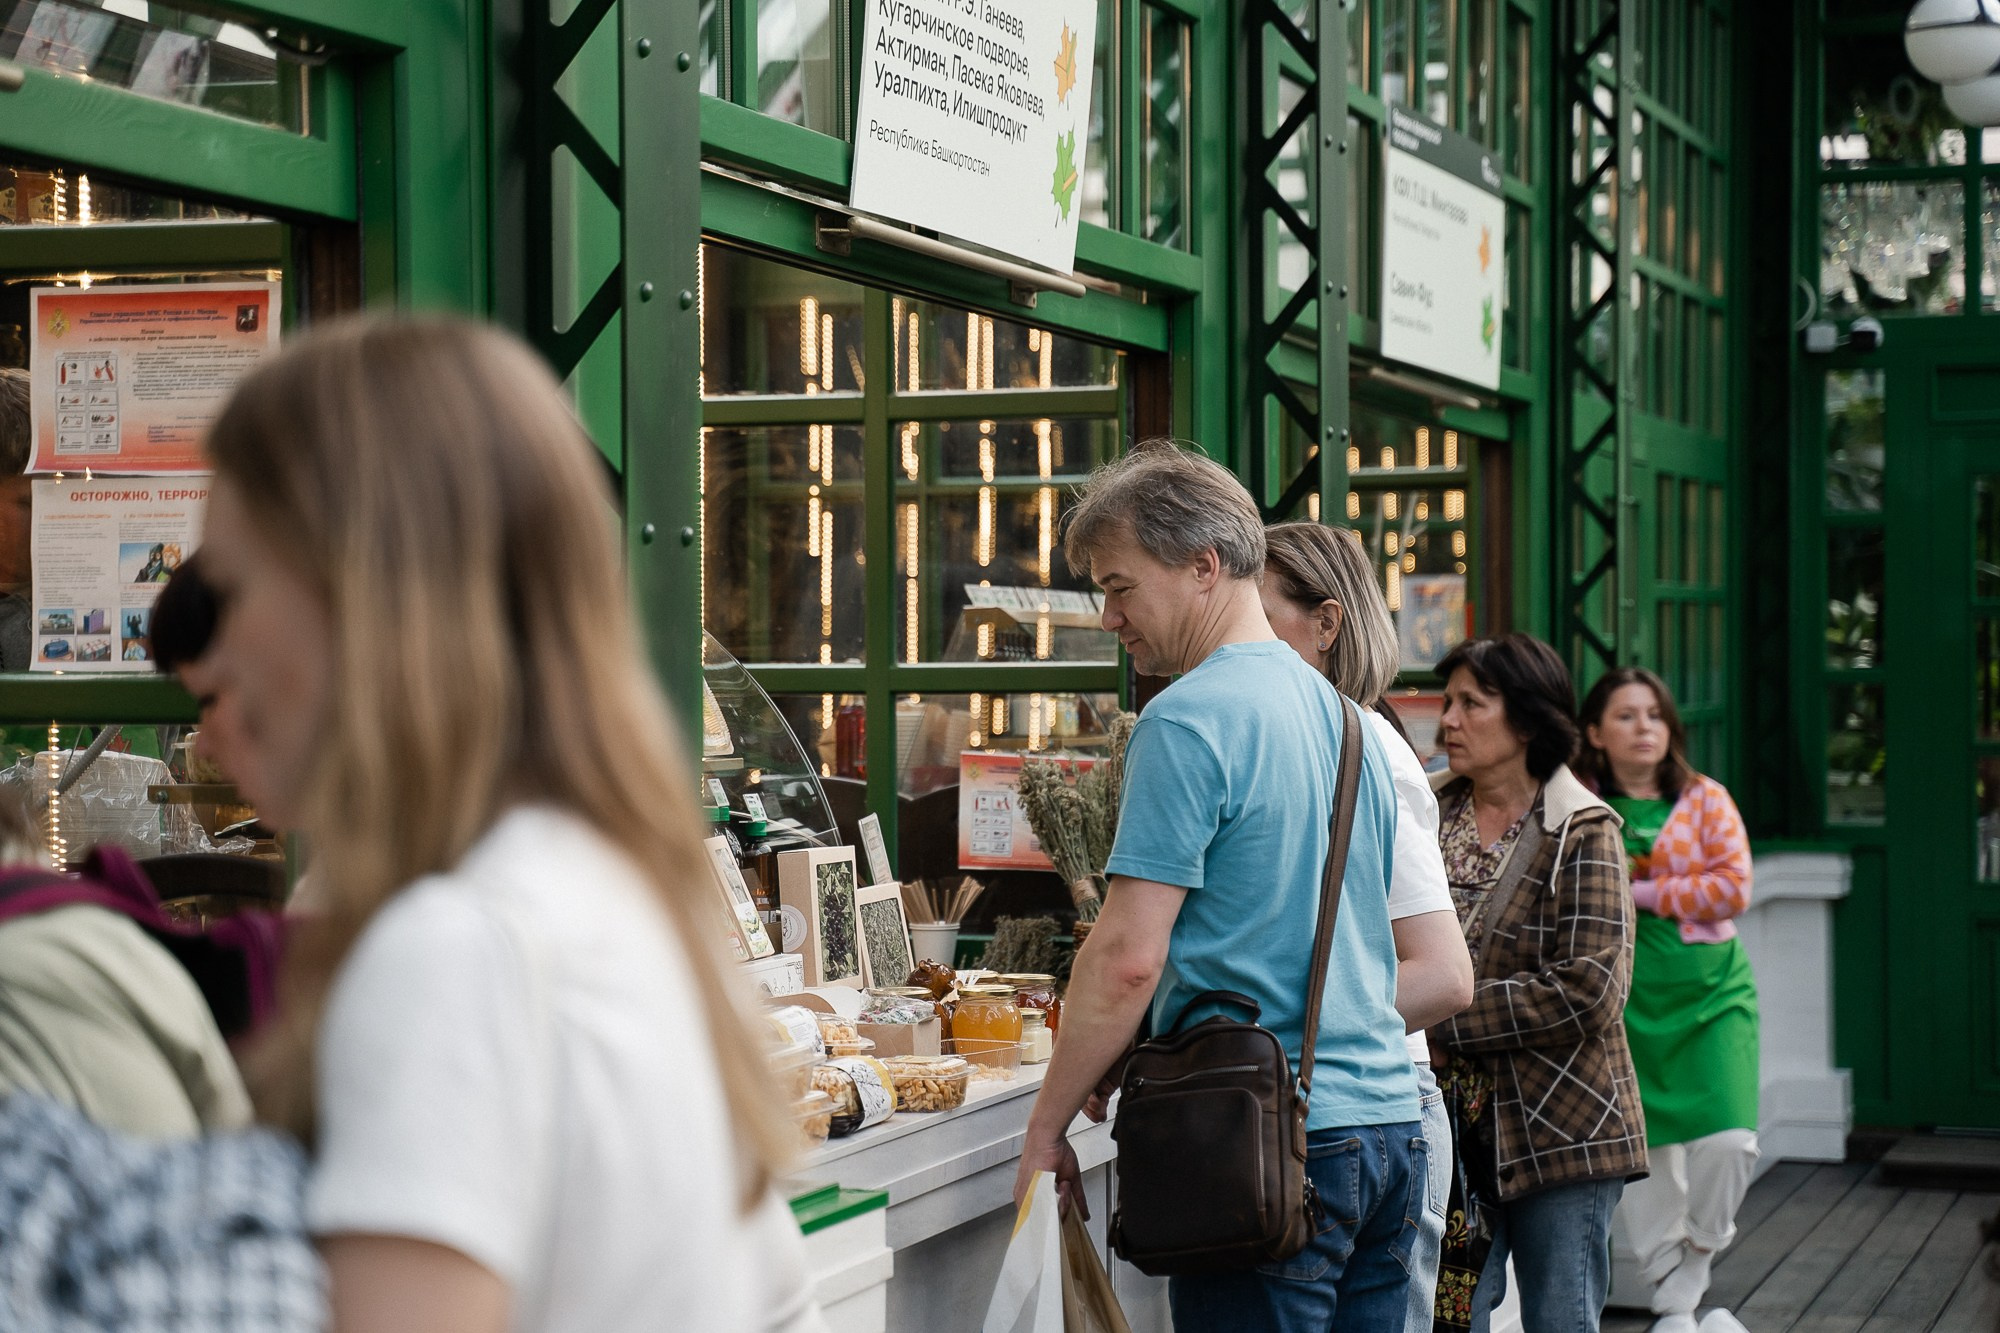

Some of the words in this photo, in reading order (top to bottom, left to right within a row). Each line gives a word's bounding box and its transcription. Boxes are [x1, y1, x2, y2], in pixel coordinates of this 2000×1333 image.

[876, 26, 949, 80] Актирман,
[952, 54, 993, 95] Пасека
[996, 74, 1045, 121] Яковлева,
[879, 0, 974, 51] Кугарчинское
[978, 36, 1030, 80] подворье,
[874, 61, 950, 117] Уралпихта,
[953, 90, 1028, 144] Илишпродукт
[870, 120, 929, 156] Республика
[932, 139, 991, 176] Башкортостан
[70, 490, 153, 502] ОСТОРОЖНО,
[158, 489, 210, 501] ТЕРРОР
